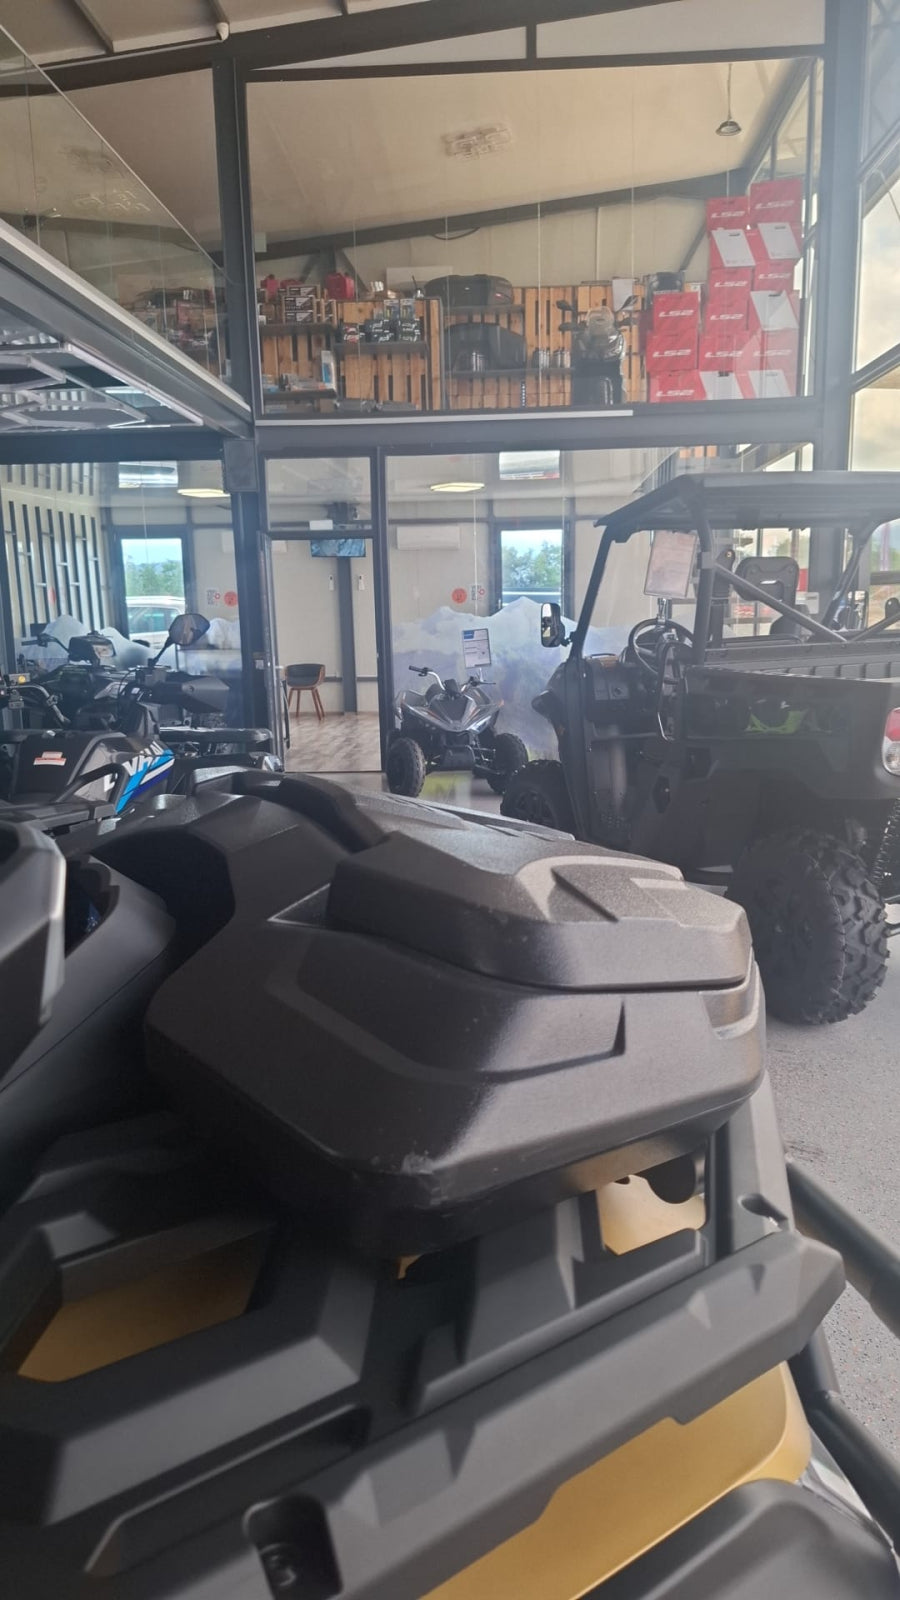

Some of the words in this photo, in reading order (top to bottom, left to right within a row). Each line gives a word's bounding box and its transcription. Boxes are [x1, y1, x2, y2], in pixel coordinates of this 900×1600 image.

[711, 211, 745, 219] LS2
[714, 280, 748, 288] LS2
[710, 313, 744, 321] LS2
[652, 349, 692, 358] LS2
[656, 389, 694, 397] LS2
[103, 740, 164, 792] LNHAI
